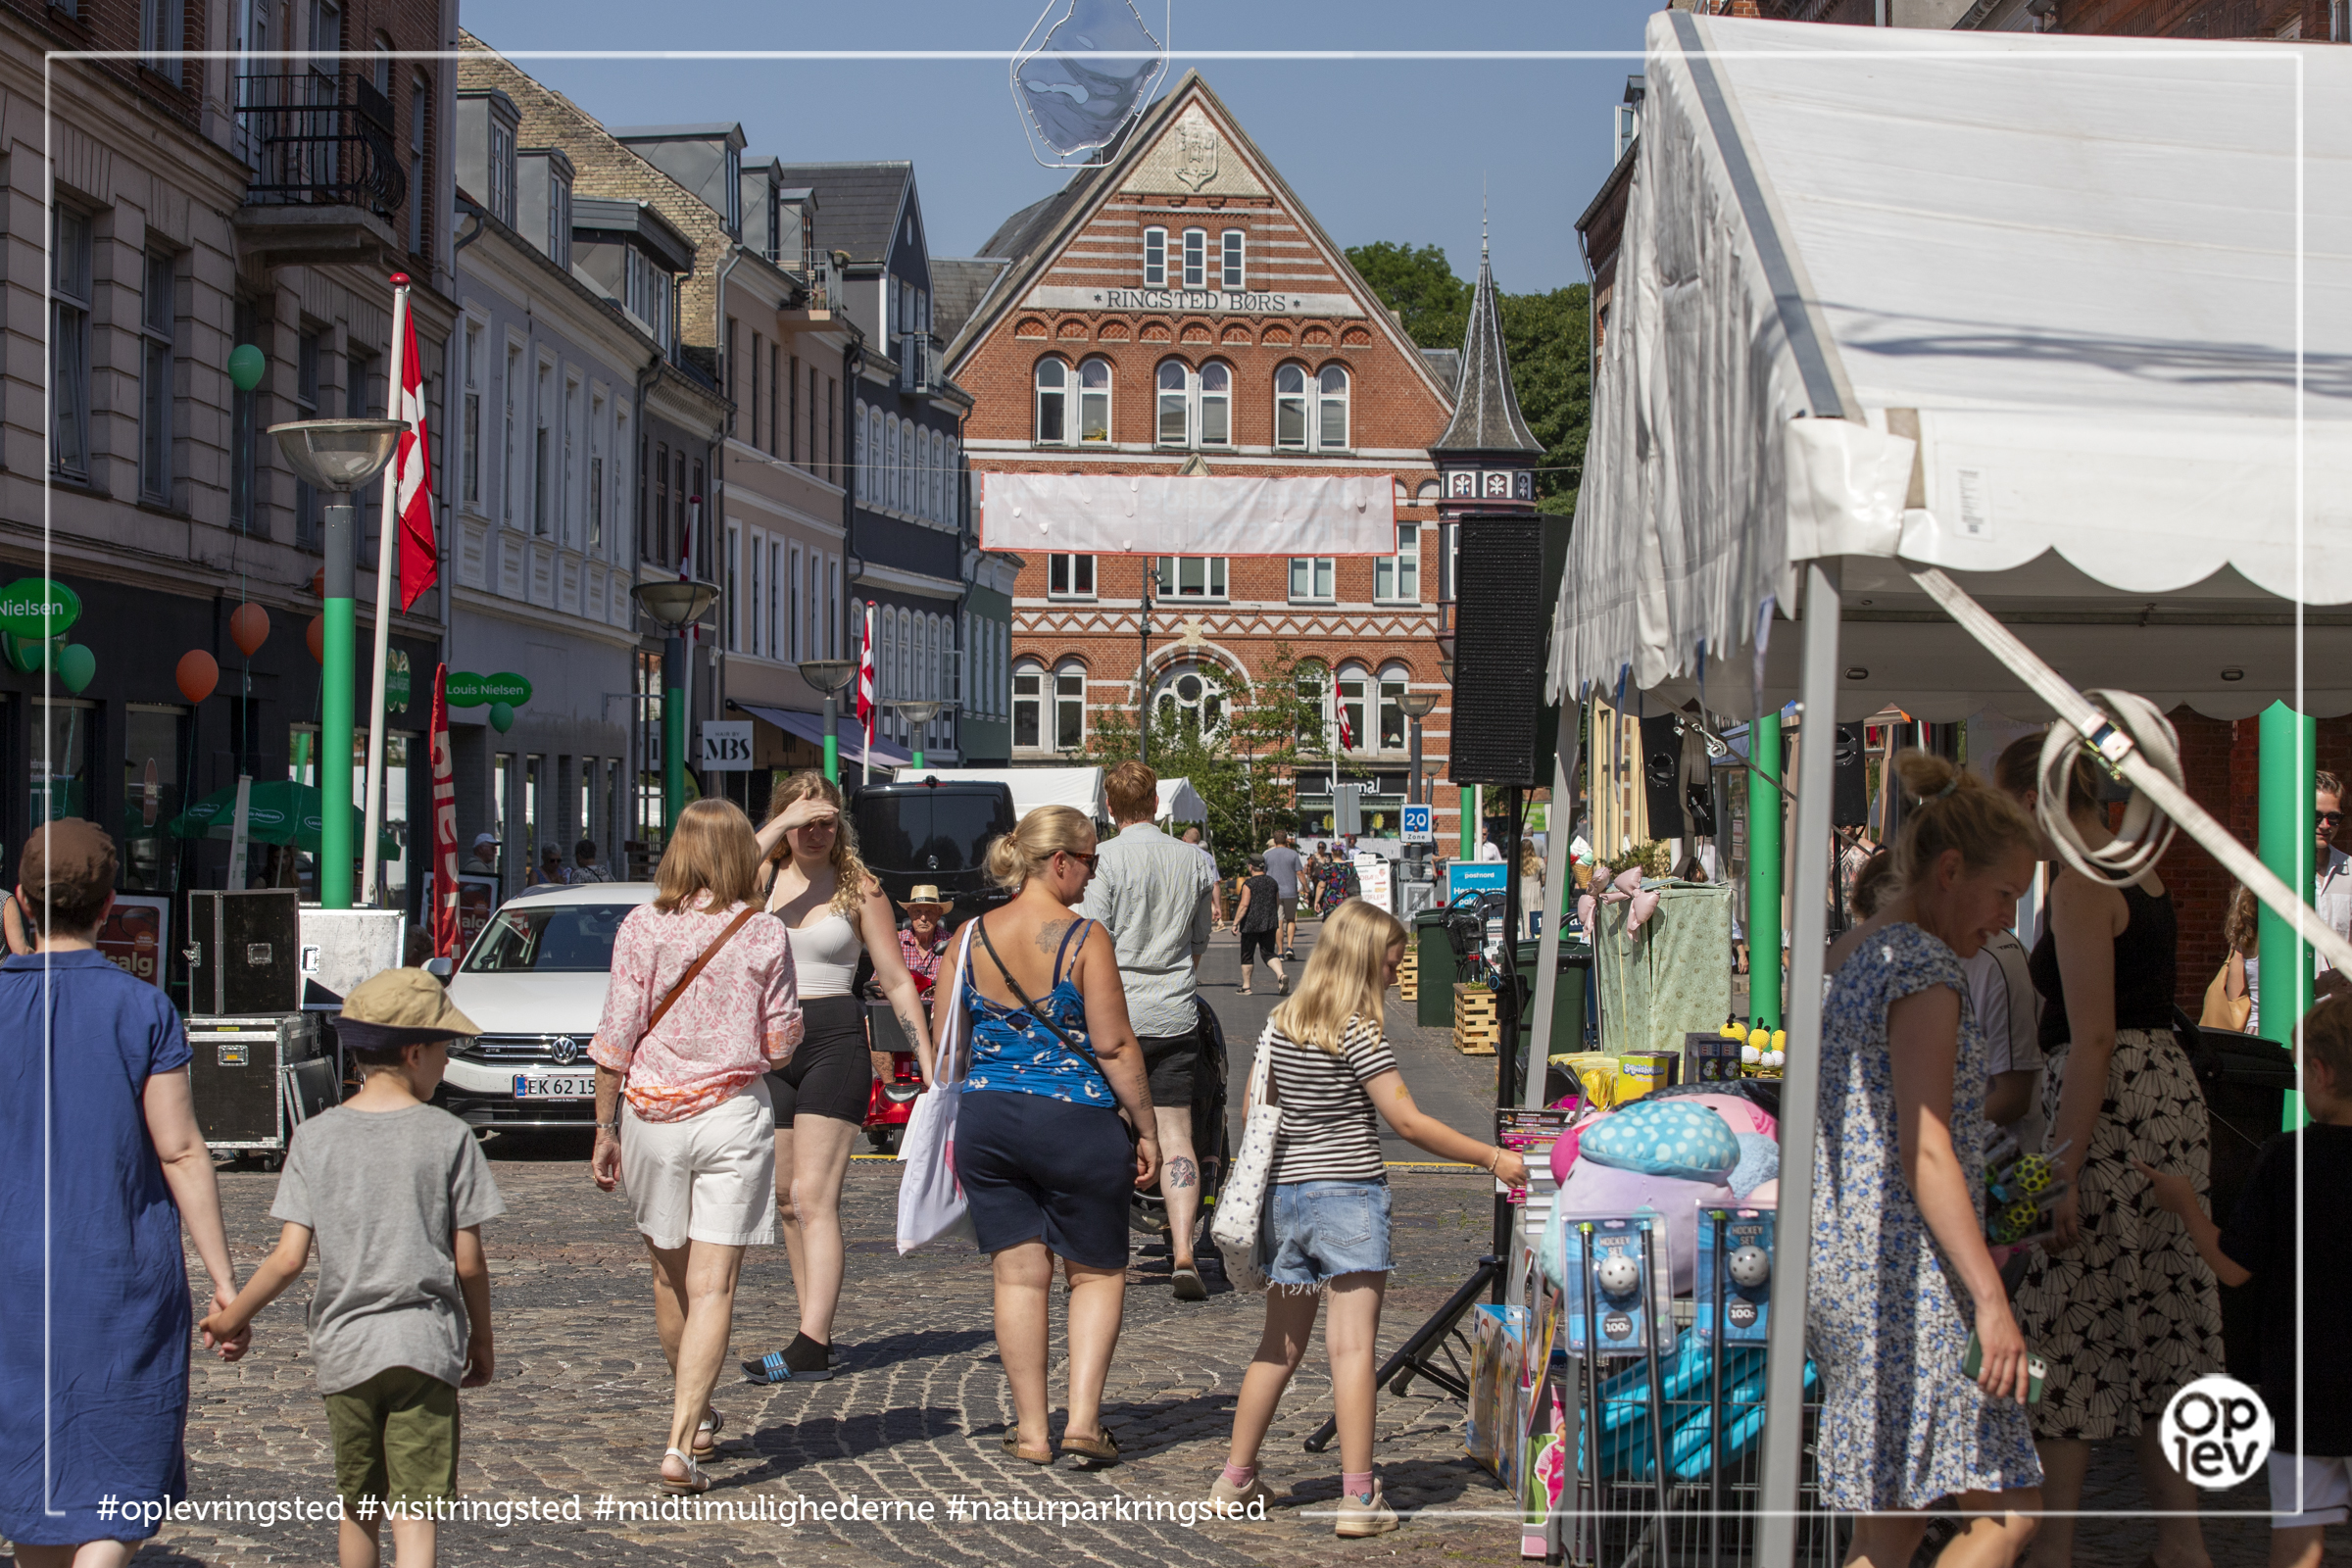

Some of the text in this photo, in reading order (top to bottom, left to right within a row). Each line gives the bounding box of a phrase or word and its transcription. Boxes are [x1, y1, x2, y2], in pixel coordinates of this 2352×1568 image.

[1107, 290, 1286, 312] RINGSTED BØRS
[0, 599, 64, 616] Nielsen
[446, 684, 524, 696] Louis Nielsen
[1325, 776, 1381, 795] Nmal
[1405, 812, 1427, 827] 20
[528, 1079, 596, 1095] EK 62 15
[1732, 1225, 1763, 1235] HOCKEY
[1599, 1236, 1631, 1246] HOCKEY
[1740, 1236, 1755, 1246] SET
